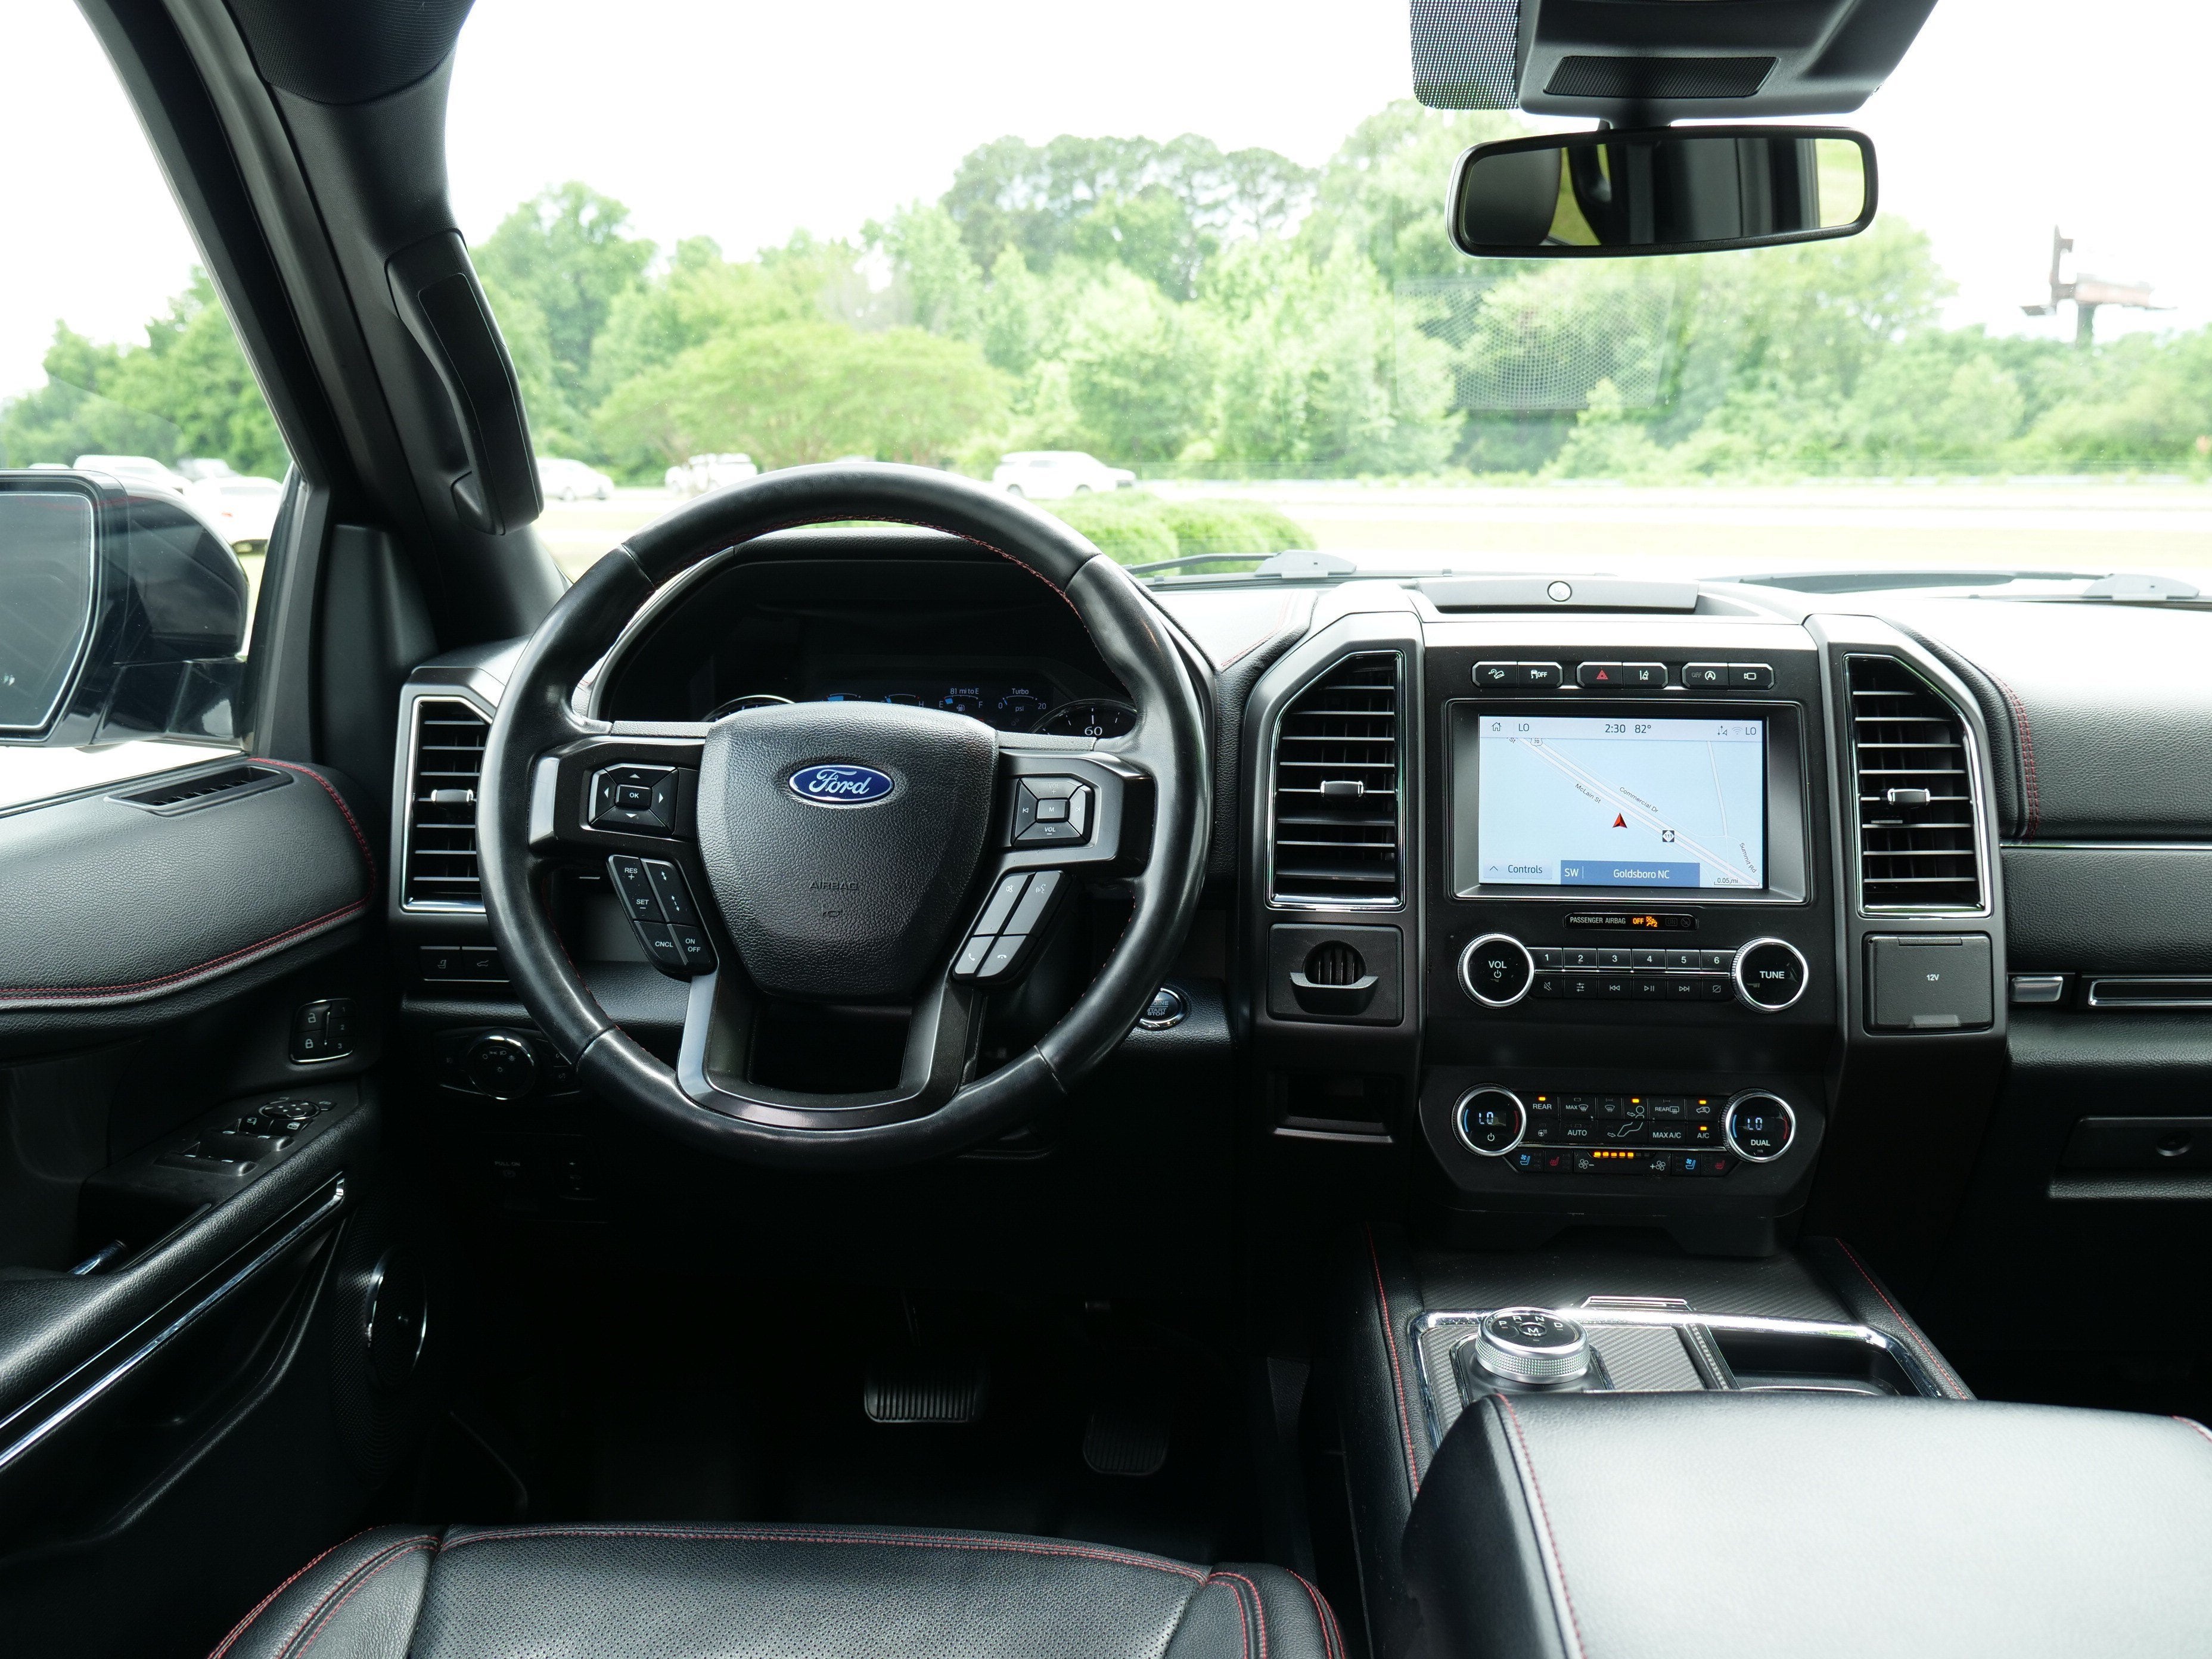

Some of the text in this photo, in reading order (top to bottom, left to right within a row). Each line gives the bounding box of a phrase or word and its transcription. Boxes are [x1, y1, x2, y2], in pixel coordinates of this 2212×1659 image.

[1085, 726, 1102, 736] 60
[1518, 723, 1530, 732] LO
[1605, 724, 1651, 734] 2:30 82°
[1745, 727, 1757, 735] LO
[809, 769, 872, 795] Ford
[1575, 784, 1595, 799] McLain
[1619, 787, 1652, 809] Commercial
[1739, 843, 1757, 873] Summit Rd
[1508, 865, 1543, 874] Controls
[1564, 868, 1670, 879] SW Goldsboro NC
[809, 881, 858, 890] AIRBAG
[1488, 961, 1507, 969] VOL
[1759, 971, 1785, 979] TUNE
[1478, 1111, 1493, 1125] LO
[1747, 1117, 1763, 1130] LO
